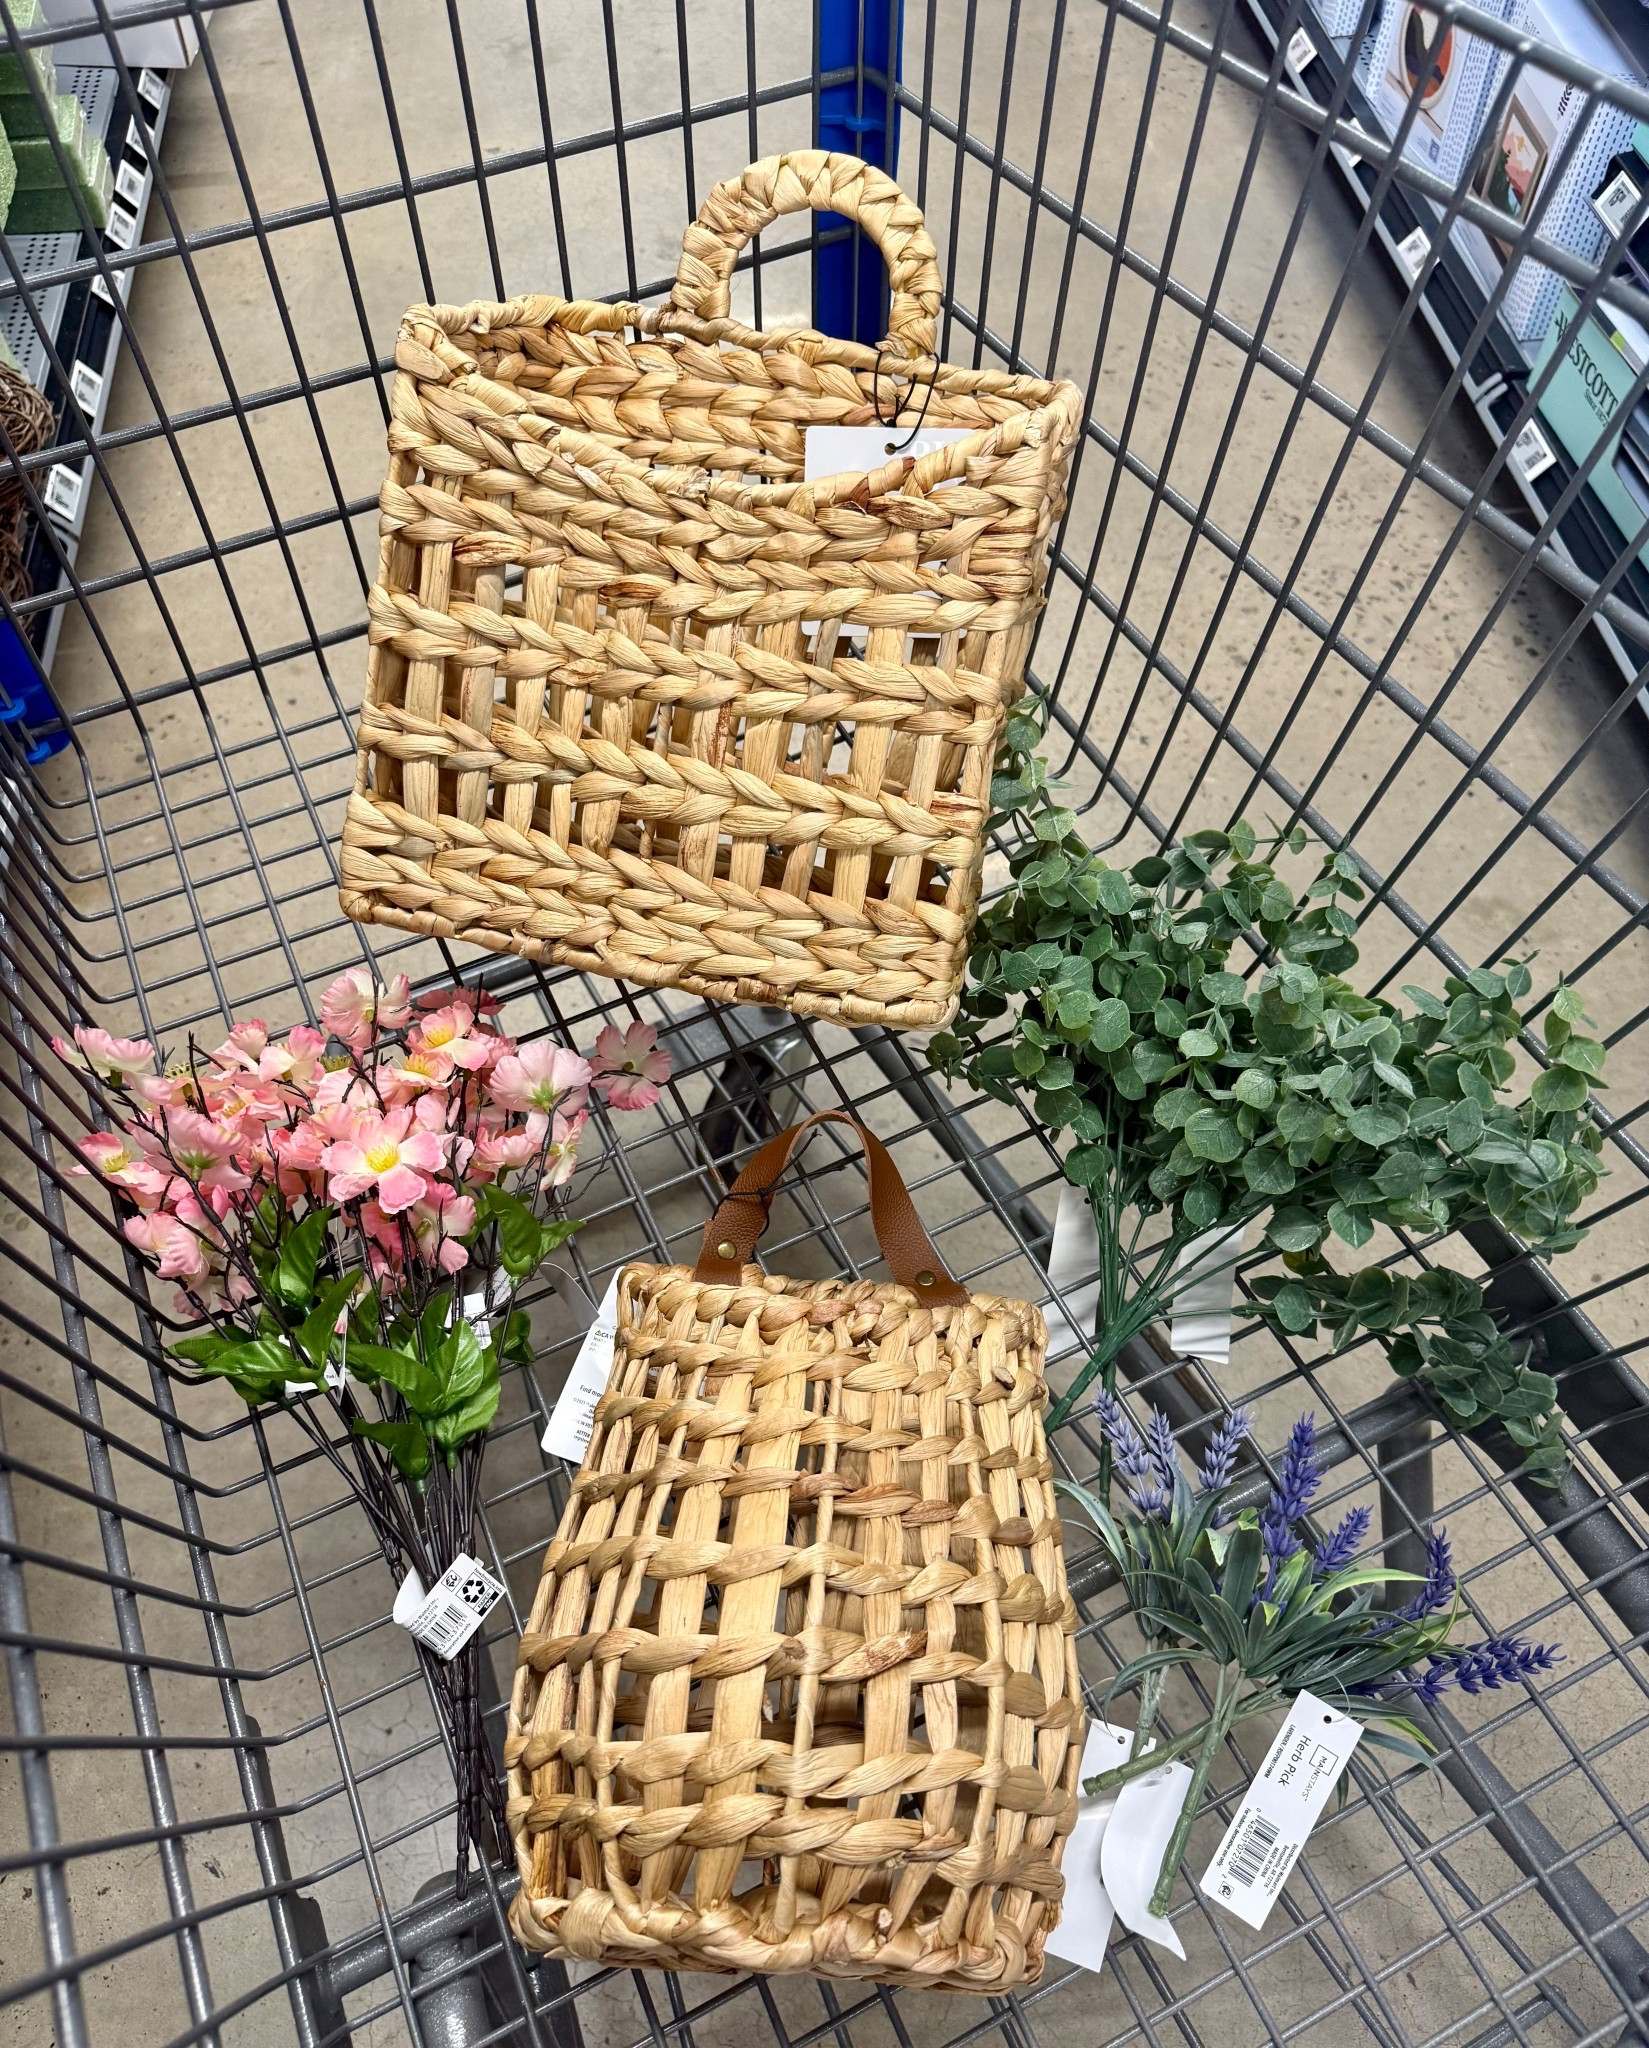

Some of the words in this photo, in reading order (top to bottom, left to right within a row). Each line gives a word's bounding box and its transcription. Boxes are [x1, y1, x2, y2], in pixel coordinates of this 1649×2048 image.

[484, 1599, 493, 1609] TAG
[418, 1604, 431, 1620] Walmart
[427, 1613, 437, 1625] CHINA
[1291, 1735, 1312, 1762] Herb
[1277, 1763, 1297, 1786] Pick
[1244, 1807, 1252, 1815] For
[1225, 1828, 1240, 1850] decorative
[1241, 1820, 1258, 1843] 46501
[1228, 1844, 1245, 1868] 07270
[1270, 1847, 1280, 1860] MADE
[1283, 1843, 1299, 1867] Distributed
[1216, 1856, 1224, 1867] only.
[1260, 1864, 1271, 1878] CHINA
[1270, 1868, 1277, 1876] AR
[1264, 1875, 1274, 1888] 72716
[1271, 1871, 1284, 1889] Walmart
